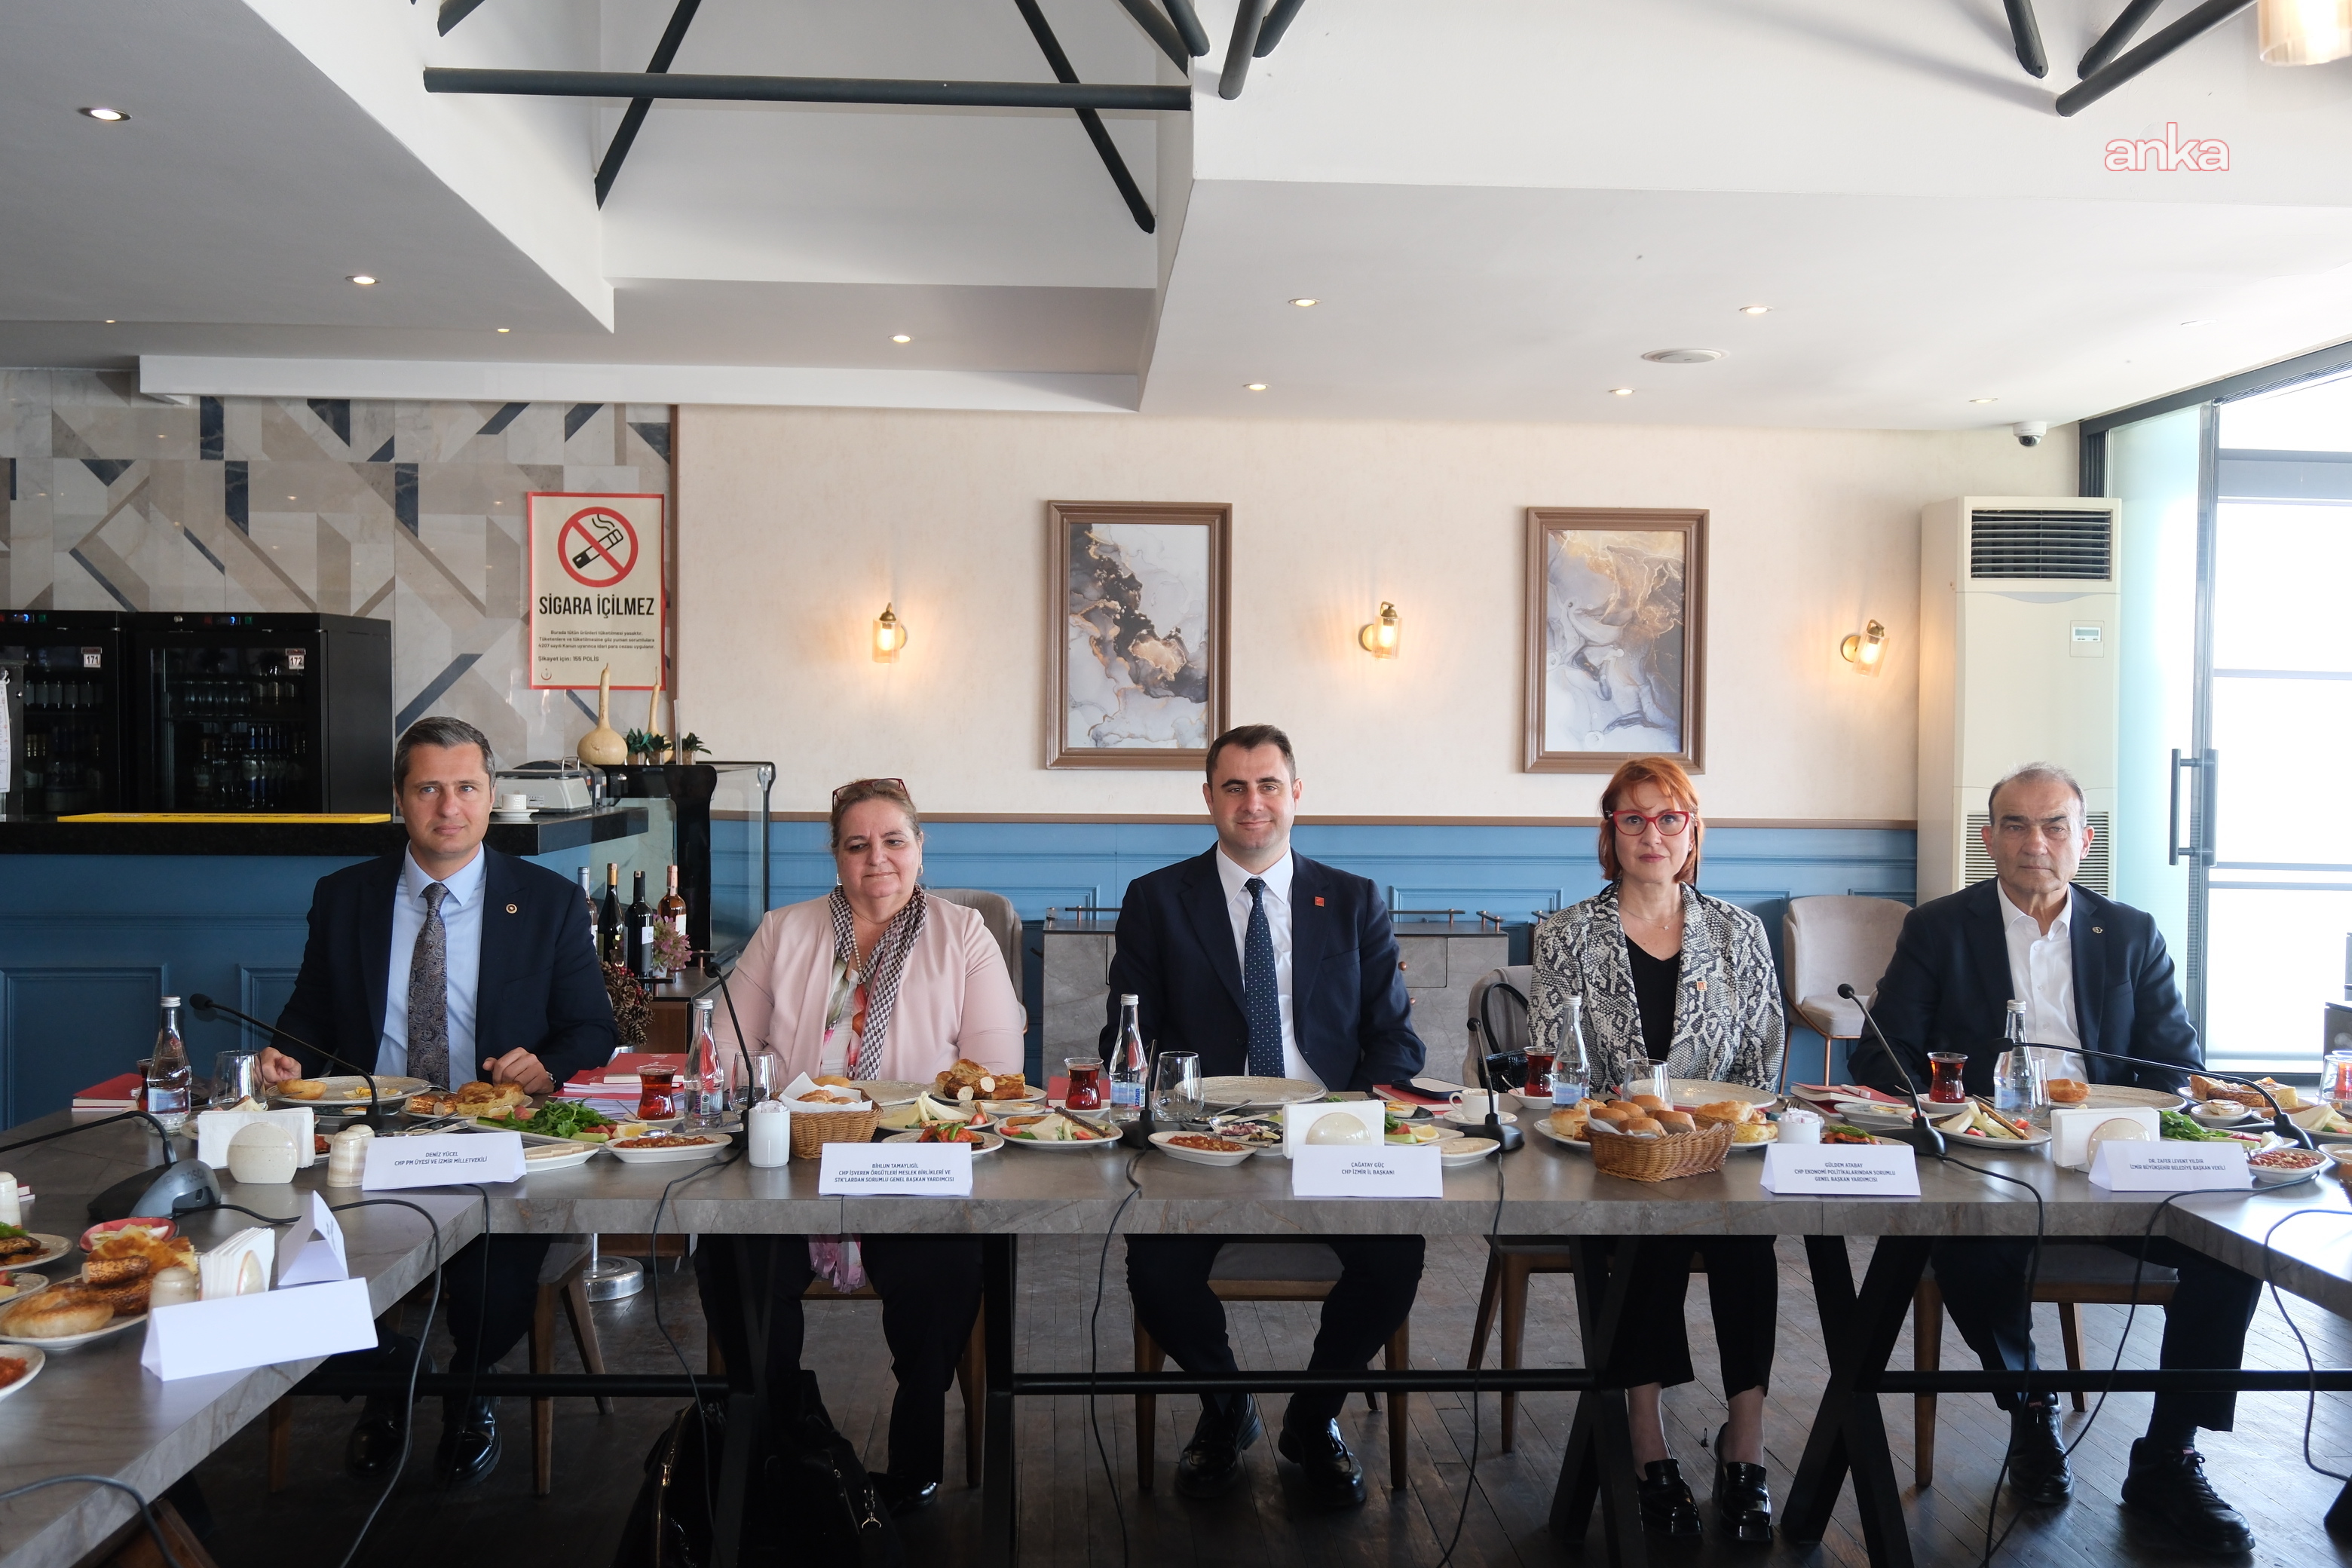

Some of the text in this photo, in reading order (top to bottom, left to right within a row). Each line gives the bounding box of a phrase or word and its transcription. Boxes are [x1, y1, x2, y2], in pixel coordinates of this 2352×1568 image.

[539, 593, 654, 619] SİGARA İÇİLMEZ
[86, 655, 100, 664] 171
